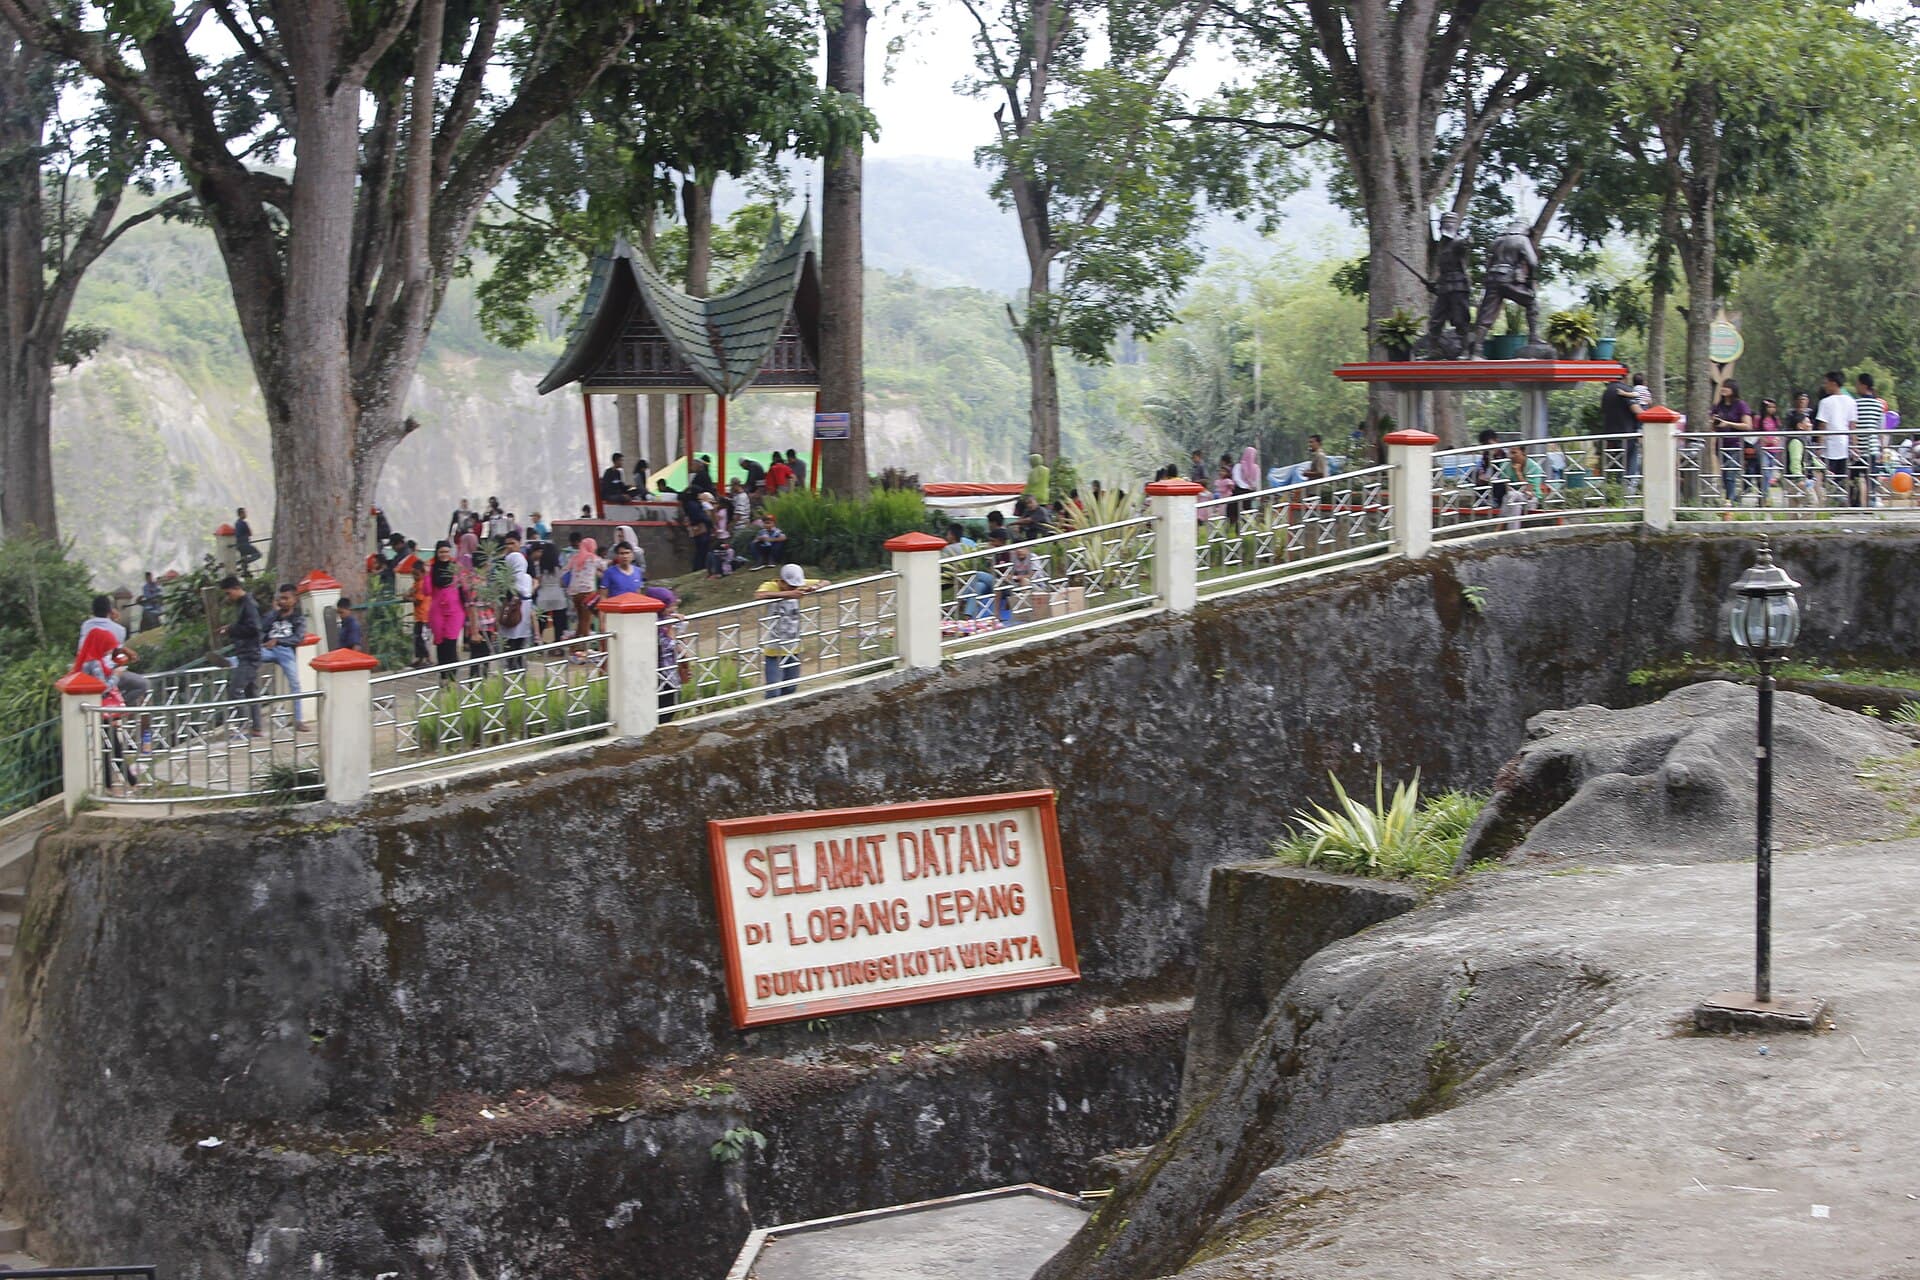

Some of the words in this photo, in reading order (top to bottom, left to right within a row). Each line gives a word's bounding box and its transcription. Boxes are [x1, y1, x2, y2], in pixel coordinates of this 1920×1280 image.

[743, 833, 887, 898] SELAMAT
[897, 819, 1021, 881] DATANG
[744, 922, 772, 945] DI
[785, 898, 910, 945] LOBANG
[918, 883, 1026, 928] JEPANG
[755, 954, 899, 999] BUKITTINGGI
[901, 946, 957, 977] KOTA
[957, 935, 1043, 969] WISATA
